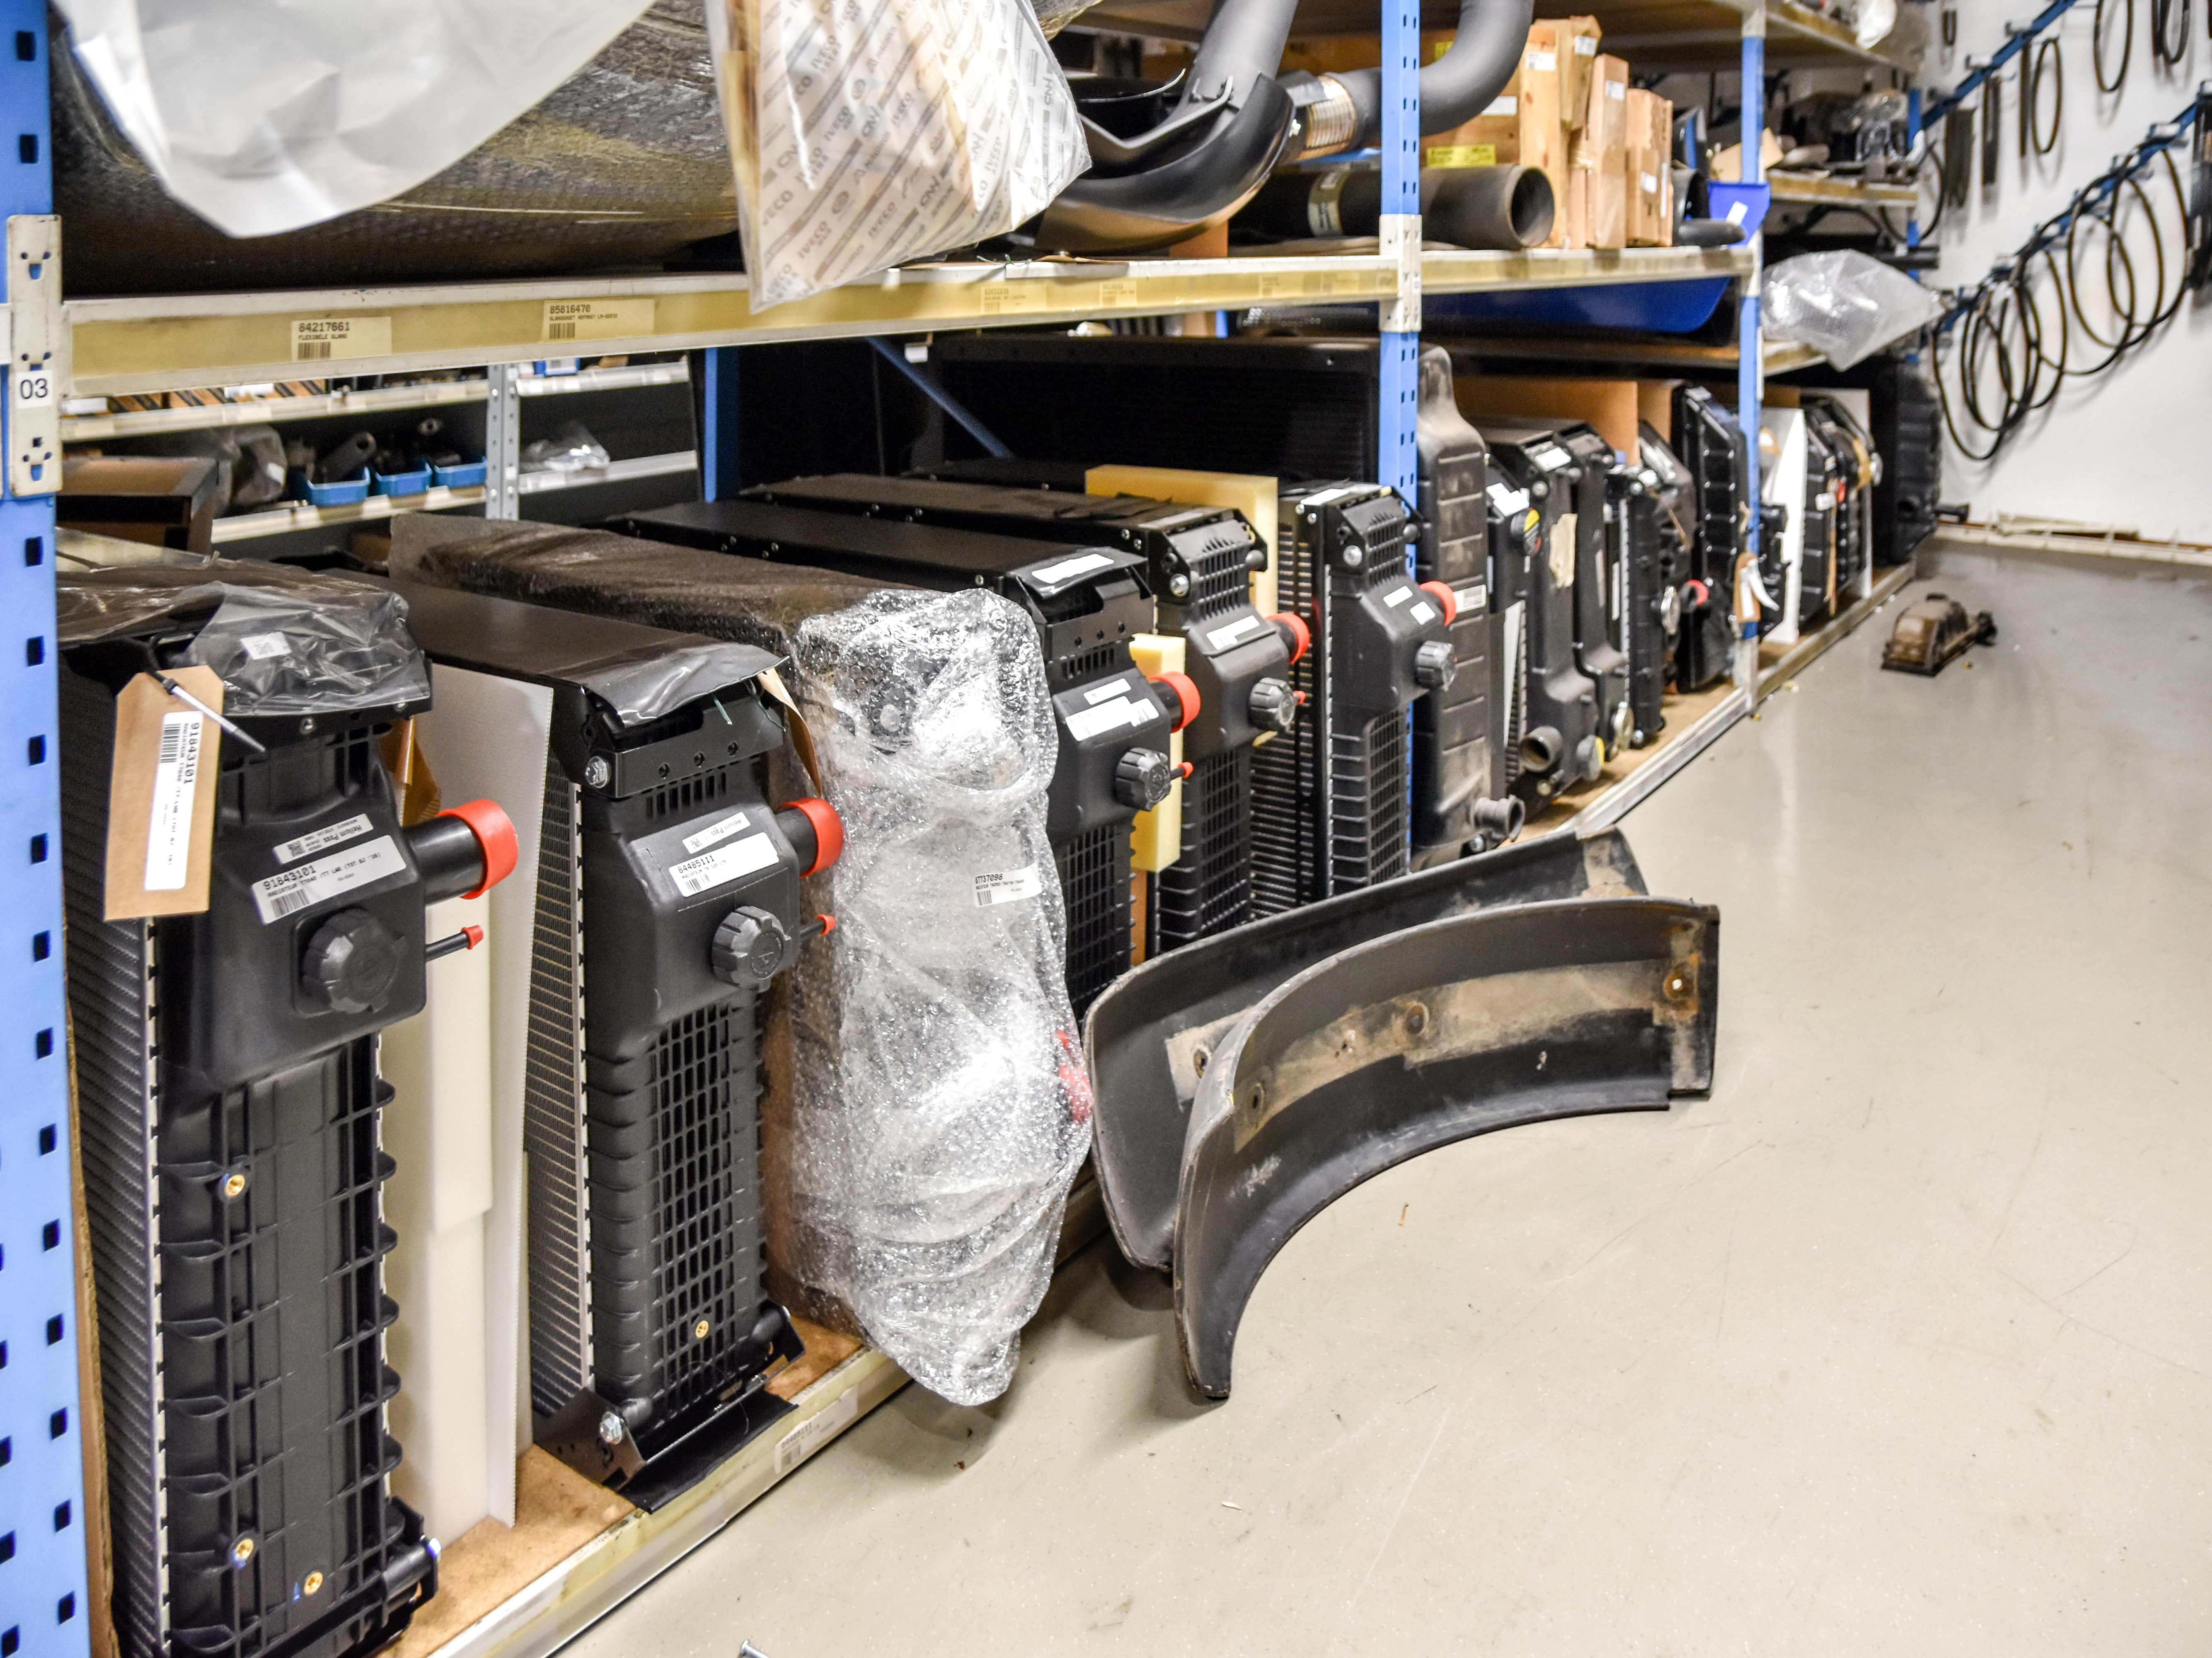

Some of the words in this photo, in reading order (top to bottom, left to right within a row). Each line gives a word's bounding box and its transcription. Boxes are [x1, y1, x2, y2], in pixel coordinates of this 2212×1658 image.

[1043, 76, 1053, 106] CNH
[862, 105, 883, 138] CNH
[920, 175, 941, 207] CNH
[868, 201, 895, 238] IVECO
[797, 221, 828, 259] IVECO
[550, 304, 591, 314] 85816470
[299, 322, 350, 332] 84217661
[20, 378, 48, 399] 03
[183, 722, 200, 784] 91843101
[322, 834, 339, 844] Pass
[340, 824, 363, 837] Helium
[678, 855, 715, 874] 84485111
[263, 865, 317, 890] 91843101
